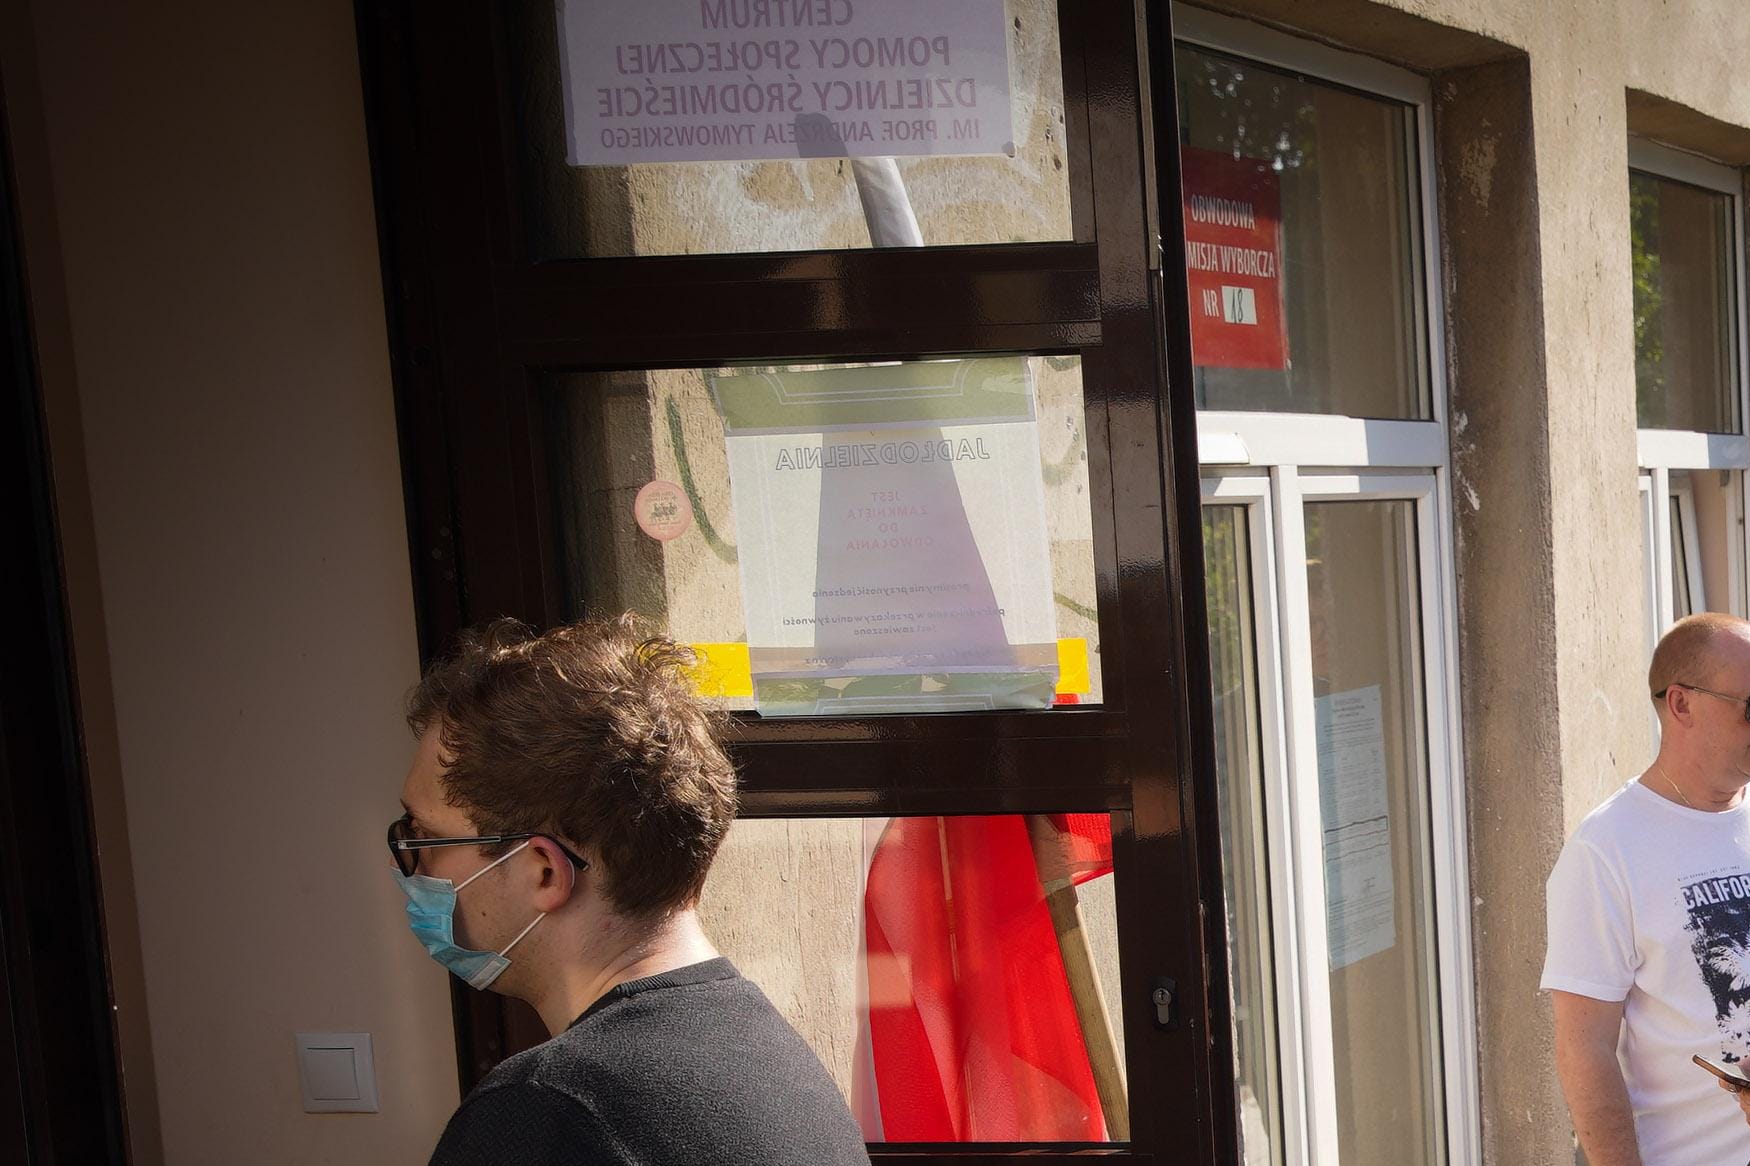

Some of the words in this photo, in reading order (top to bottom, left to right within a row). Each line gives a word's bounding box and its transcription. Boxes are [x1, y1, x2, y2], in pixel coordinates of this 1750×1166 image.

[1191, 195, 1256, 230] OBWODOWA
[1220, 245, 1276, 278] WYBORCZA
[1202, 288, 1220, 318] NR
[1231, 288, 1244, 324] 18
